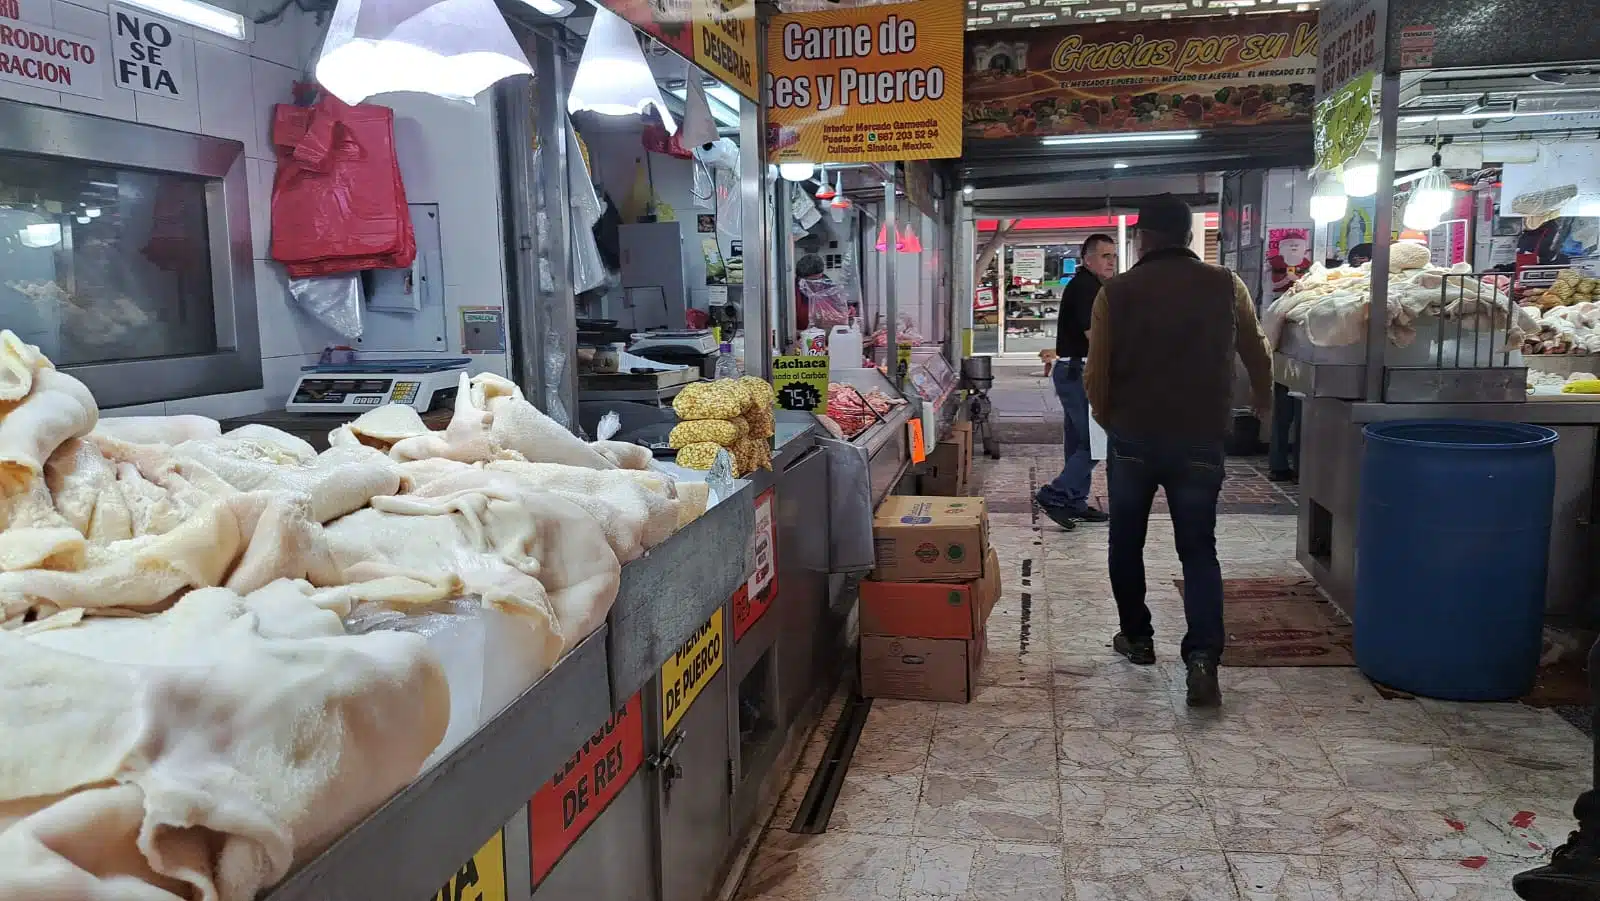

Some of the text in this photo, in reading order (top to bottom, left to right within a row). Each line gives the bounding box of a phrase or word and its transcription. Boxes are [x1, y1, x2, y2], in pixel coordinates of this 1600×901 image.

[116, 12, 172, 47] NO
[783, 15, 916, 61] Carne de
[130, 42, 162, 66] SE
[702, 26, 752, 87] DESEBRAR
[1053, 35, 1172, 72] Gracias
[1173, 35, 1237, 73] por
[1239, 33, 1287, 61] su
[119, 59, 179, 95] FIA
[816, 76, 834, 111] y
[840, 65, 944, 105] Puerco
[1258, 68, 1294, 77] MERCADO
[823, 135, 851, 143] Puesto
[895, 130, 914, 140] 203
[928, 129, 938, 138] 94
[855, 122, 892, 132] Mercado
[666, 632, 721, 720] DE PUERCO
[562, 739, 623, 832] DE RES
